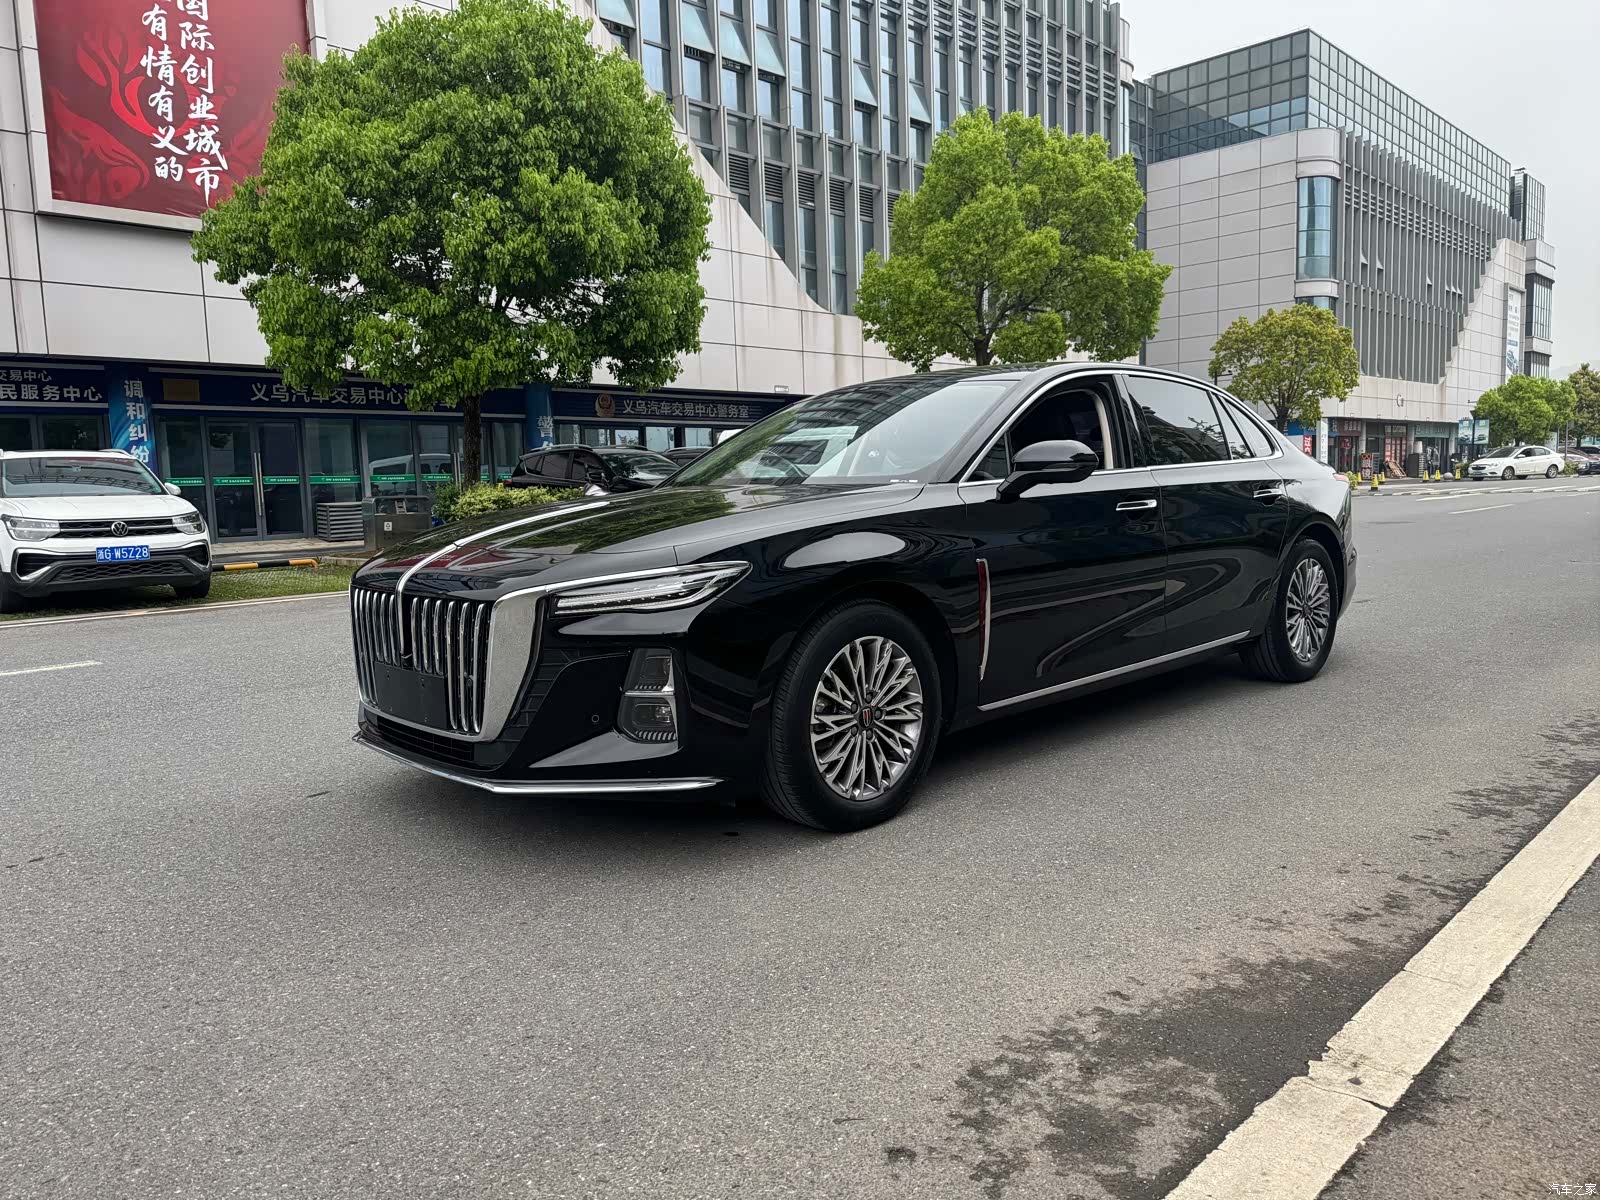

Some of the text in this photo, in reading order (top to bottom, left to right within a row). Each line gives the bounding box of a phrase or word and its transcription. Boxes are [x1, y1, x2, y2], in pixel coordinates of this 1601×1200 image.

[140, 0, 189, 182] 有情有义的
[177, 0, 228, 207] 国际创业城市
[0, 384, 102, 401] 民服务中心
[250, 382, 457, 408] 义乌汽车交易中心
[623, 399, 750, 418] 义乌汽车交易中心警务室
[123, 379, 150, 463] 调和纠纷
